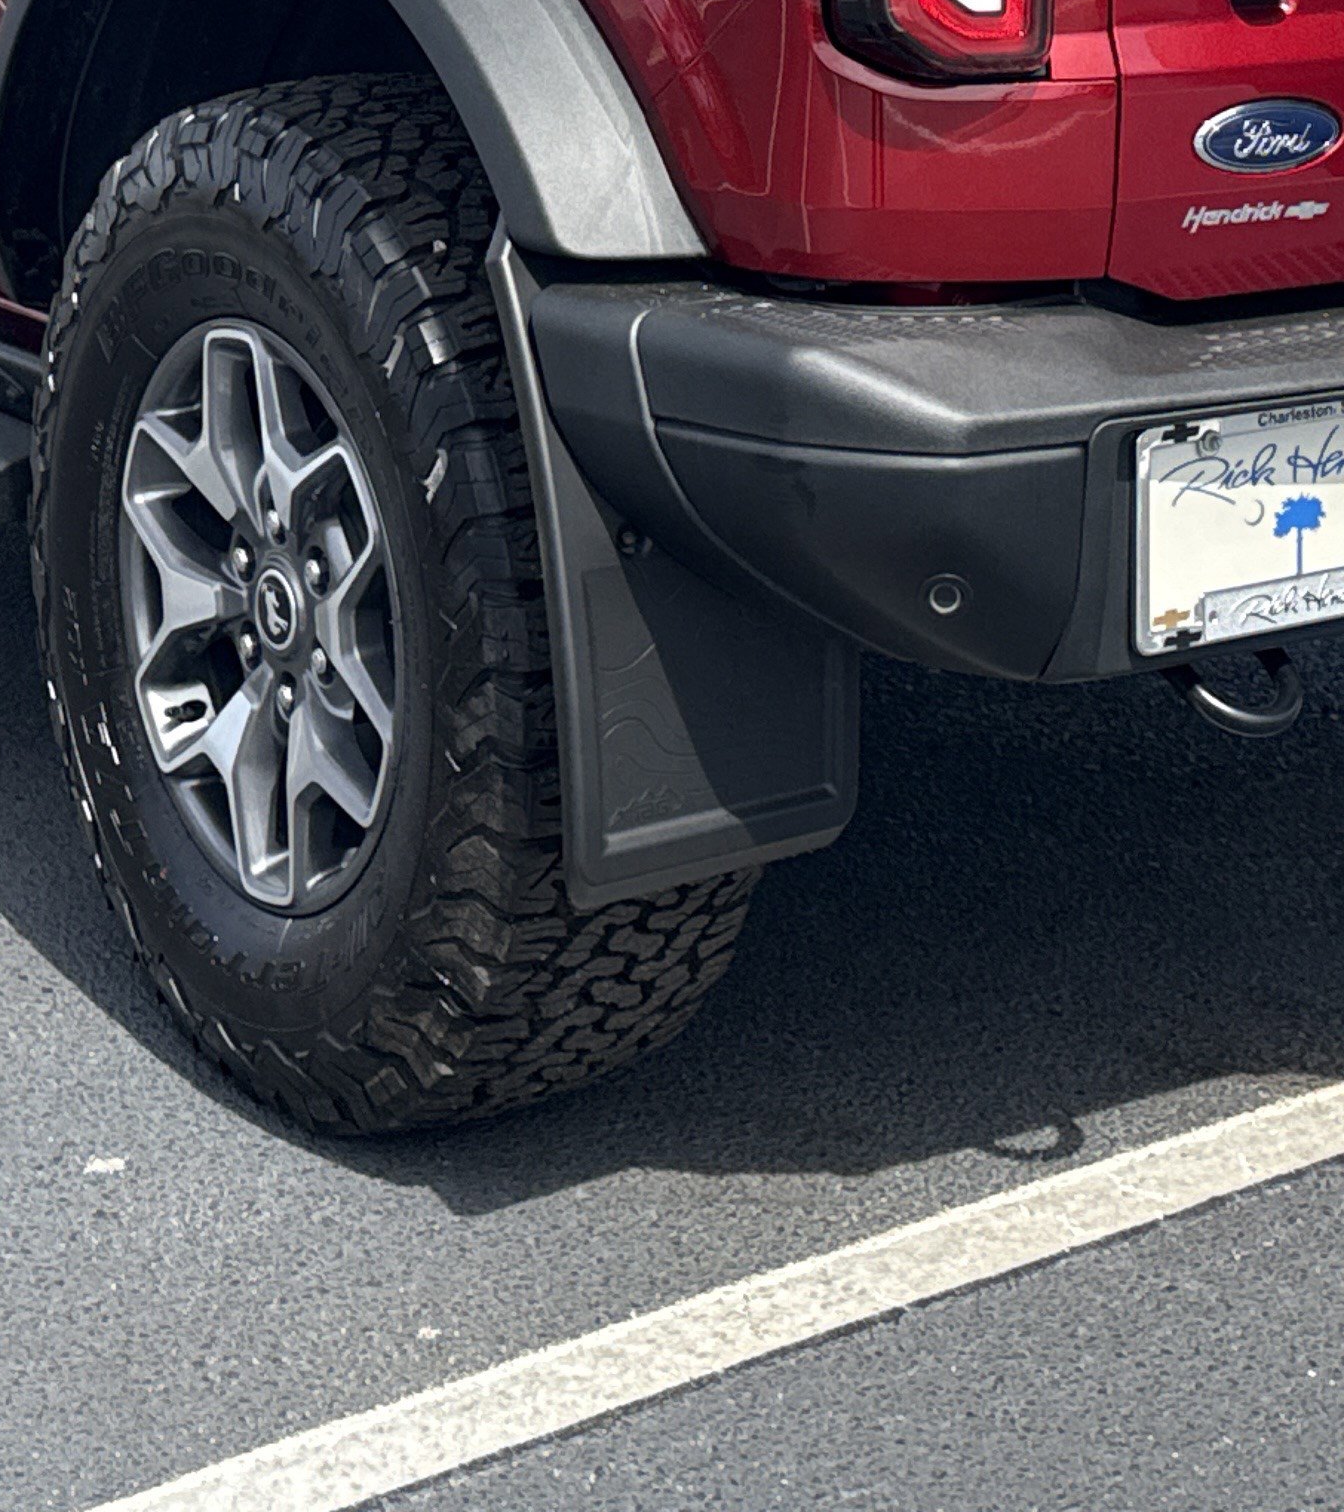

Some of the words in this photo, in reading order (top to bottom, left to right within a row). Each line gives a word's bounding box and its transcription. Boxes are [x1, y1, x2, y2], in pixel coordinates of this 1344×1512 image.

[1233, 118, 1312, 159] Ford
[1181, 201, 1284, 234] Hendrick
[1158, 443, 1278, 507] Rick
[1228, 585, 1299, 628] Rick
